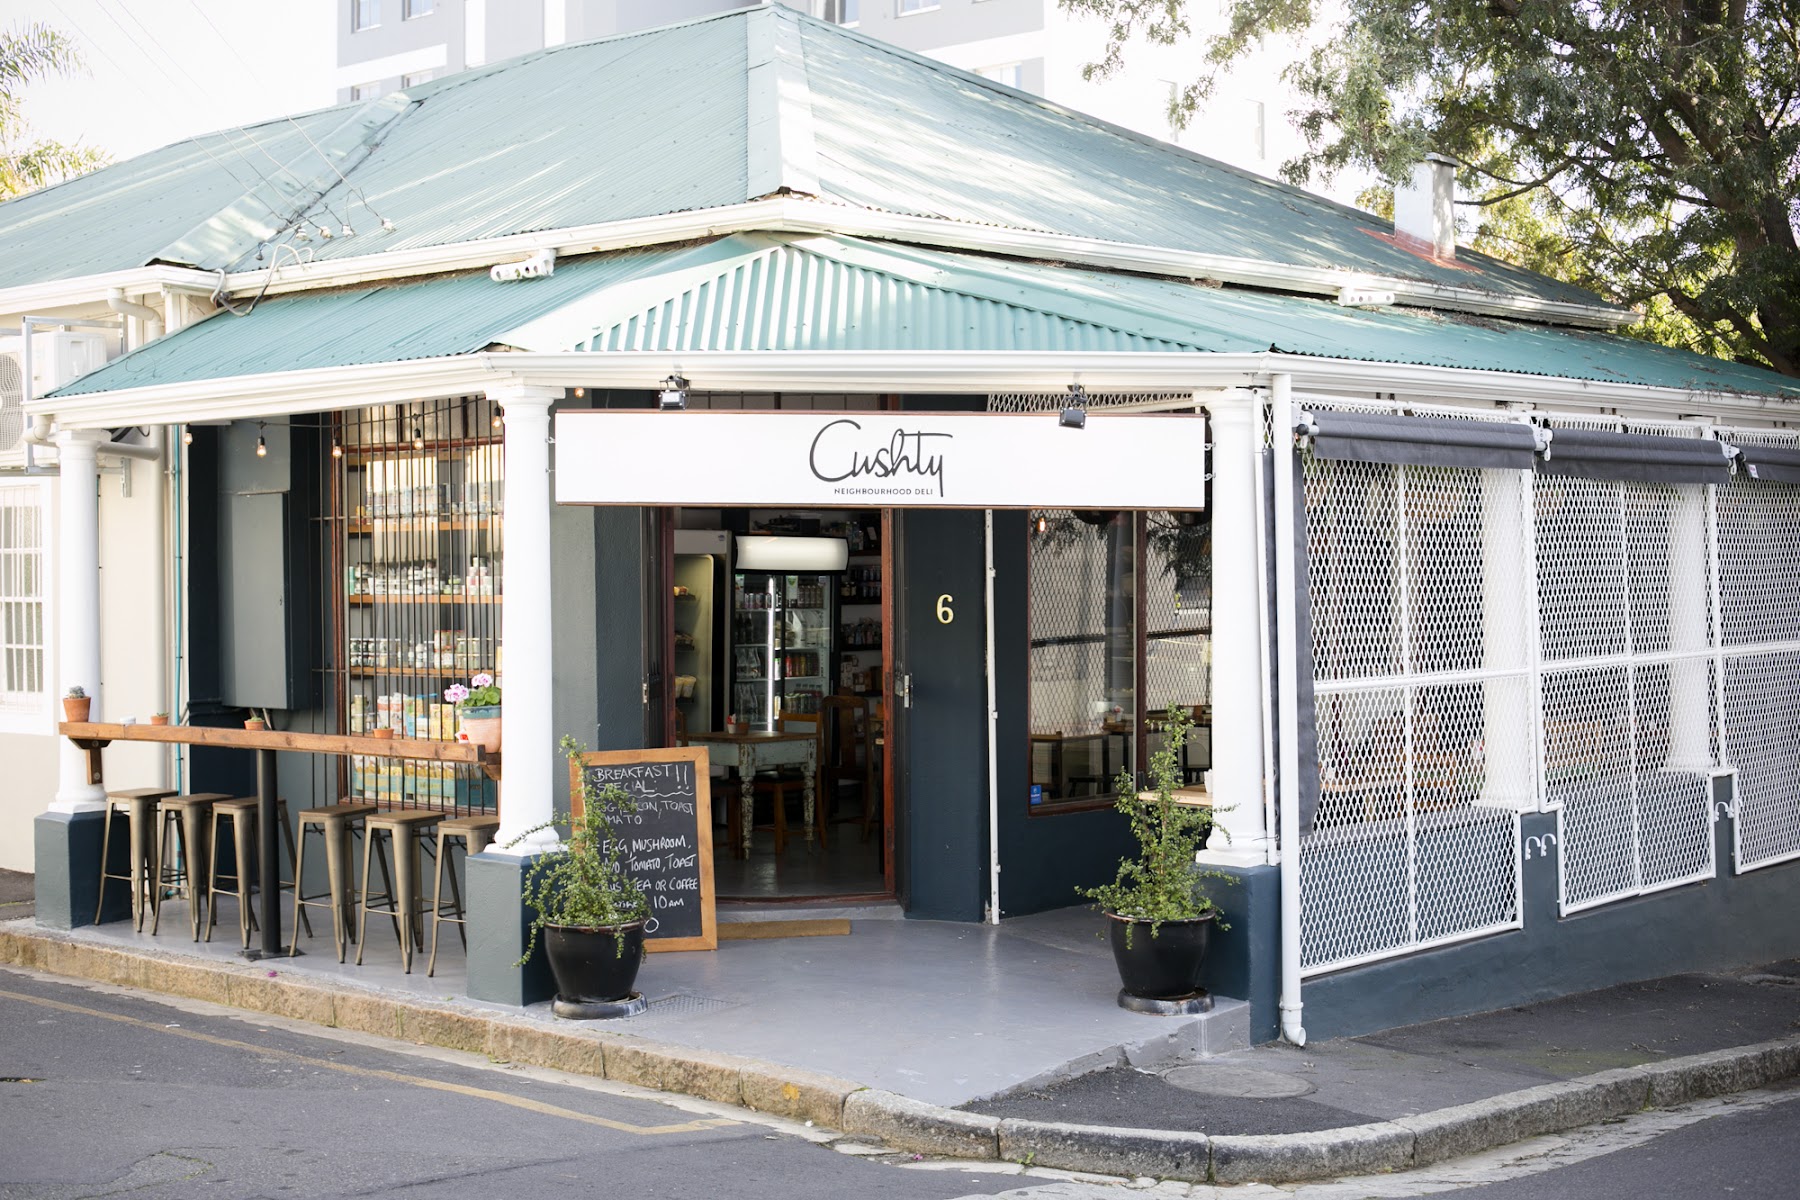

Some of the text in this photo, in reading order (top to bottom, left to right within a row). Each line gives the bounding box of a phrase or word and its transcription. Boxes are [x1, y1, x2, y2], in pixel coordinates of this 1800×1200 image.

[809, 419, 953, 498] Cushty
[834, 488, 933, 496] NEIGHBOURHOOD DELI
[936, 594, 954, 624] 6
[665, 853, 697, 870] TOAST
[655, 879, 667, 891] OR
[669, 877, 698, 891] COFFEE
